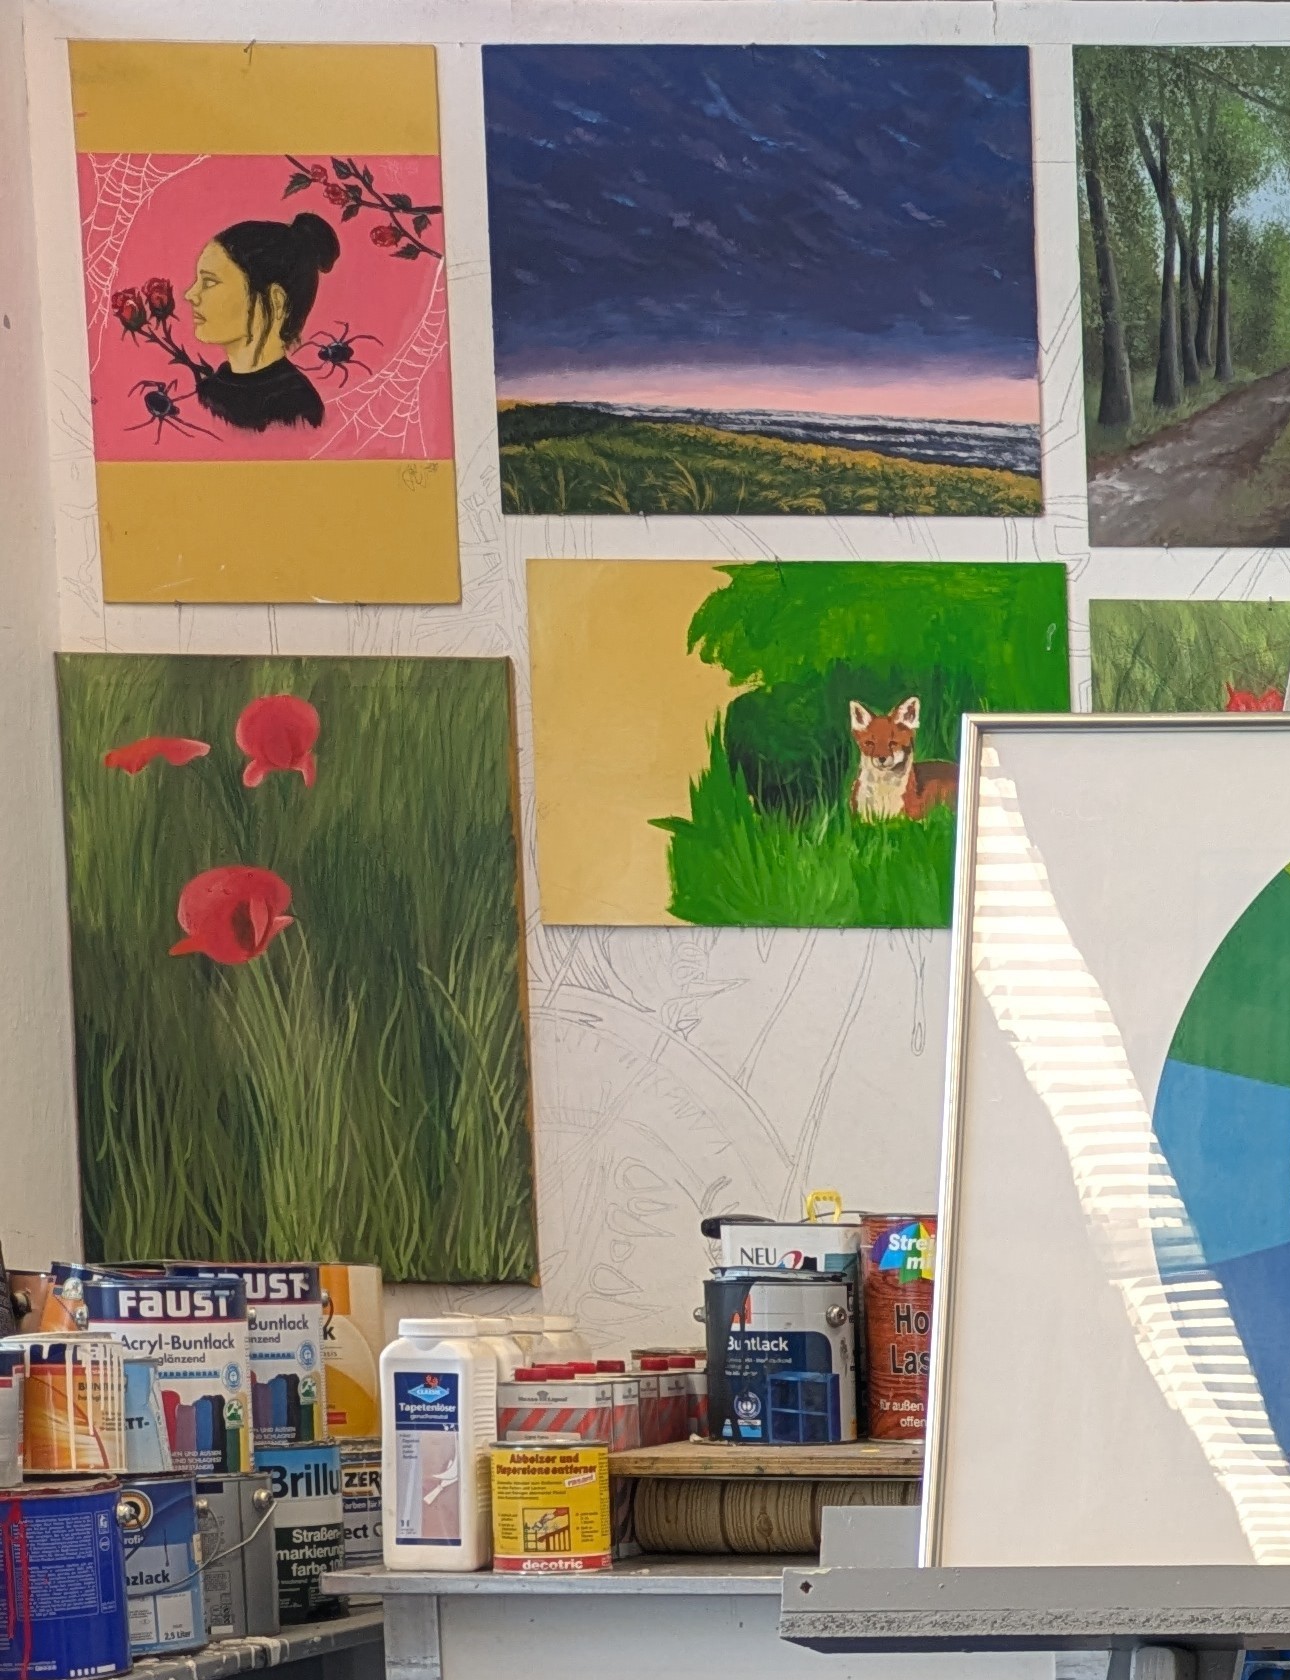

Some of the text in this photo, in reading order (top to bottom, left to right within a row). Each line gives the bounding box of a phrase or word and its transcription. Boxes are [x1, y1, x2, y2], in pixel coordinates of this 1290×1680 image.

[888, 1233, 936, 1251] Strei
[739, 1247, 777, 1266] NEU
[248, 1314, 309, 1331] Buntlack
[121, 1332, 236, 1355] Acryl-Buntlack
[157, 1353, 206, 1366] glänzend
[399, 1402, 457, 1414] Tapetenlöser
[559, 1453, 579, 1464] und
[344, 1470, 382, 1492] ZER
[522, 1558, 584, 1570] decotric
